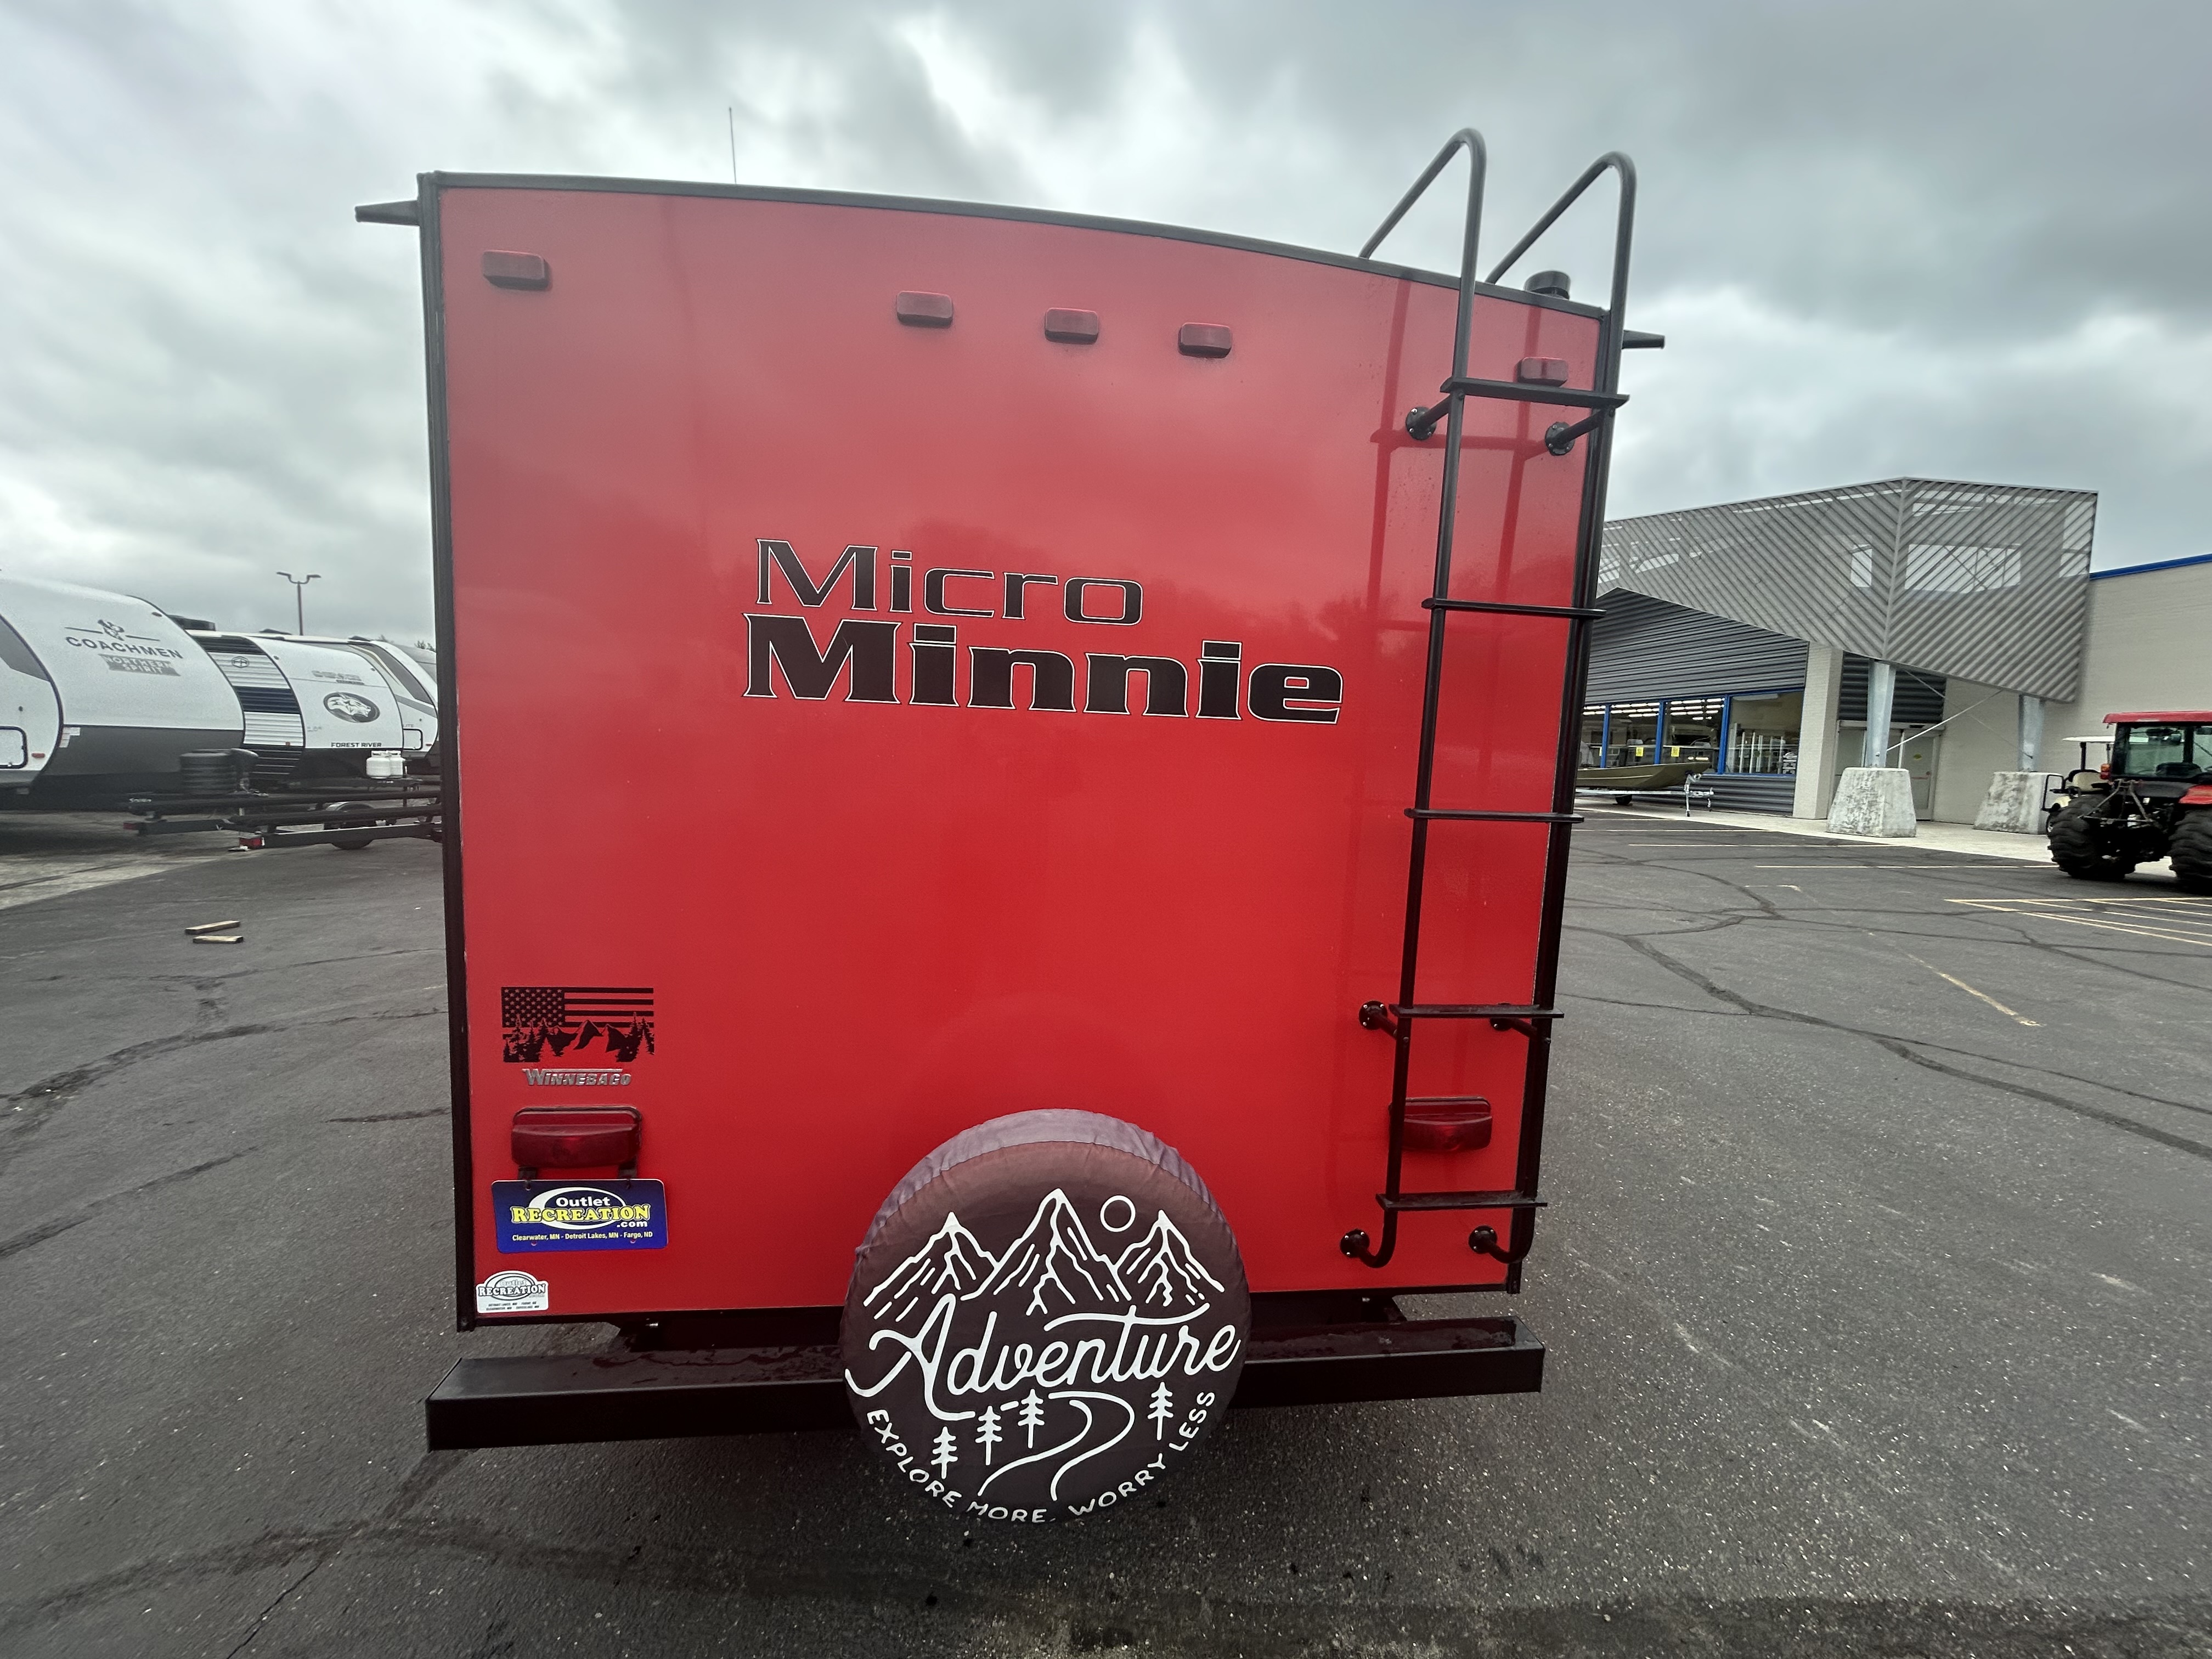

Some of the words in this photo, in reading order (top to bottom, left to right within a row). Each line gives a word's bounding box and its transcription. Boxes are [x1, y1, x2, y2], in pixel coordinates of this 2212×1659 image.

[755, 537, 1143, 627] Micro
[66, 636, 183, 658] COACHMEN
[122, 664, 163, 674] SPIRIT
[742, 612, 1344, 725] Minnie
[522, 1068, 632, 1086] WINNEBAGO
[556, 1196, 611, 1207] Outlet
[511, 1204, 650, 1222] RECREATION
[478, 1283, 546, 1296] RECREATION
[844, 1294, 1242, 1420] Adventure
[867, 1409, 962, 1508] EXPLORE
[1068, 1453, 1166, 1516] WORRY
[1169, 1392, 1215, 1452] LESS
